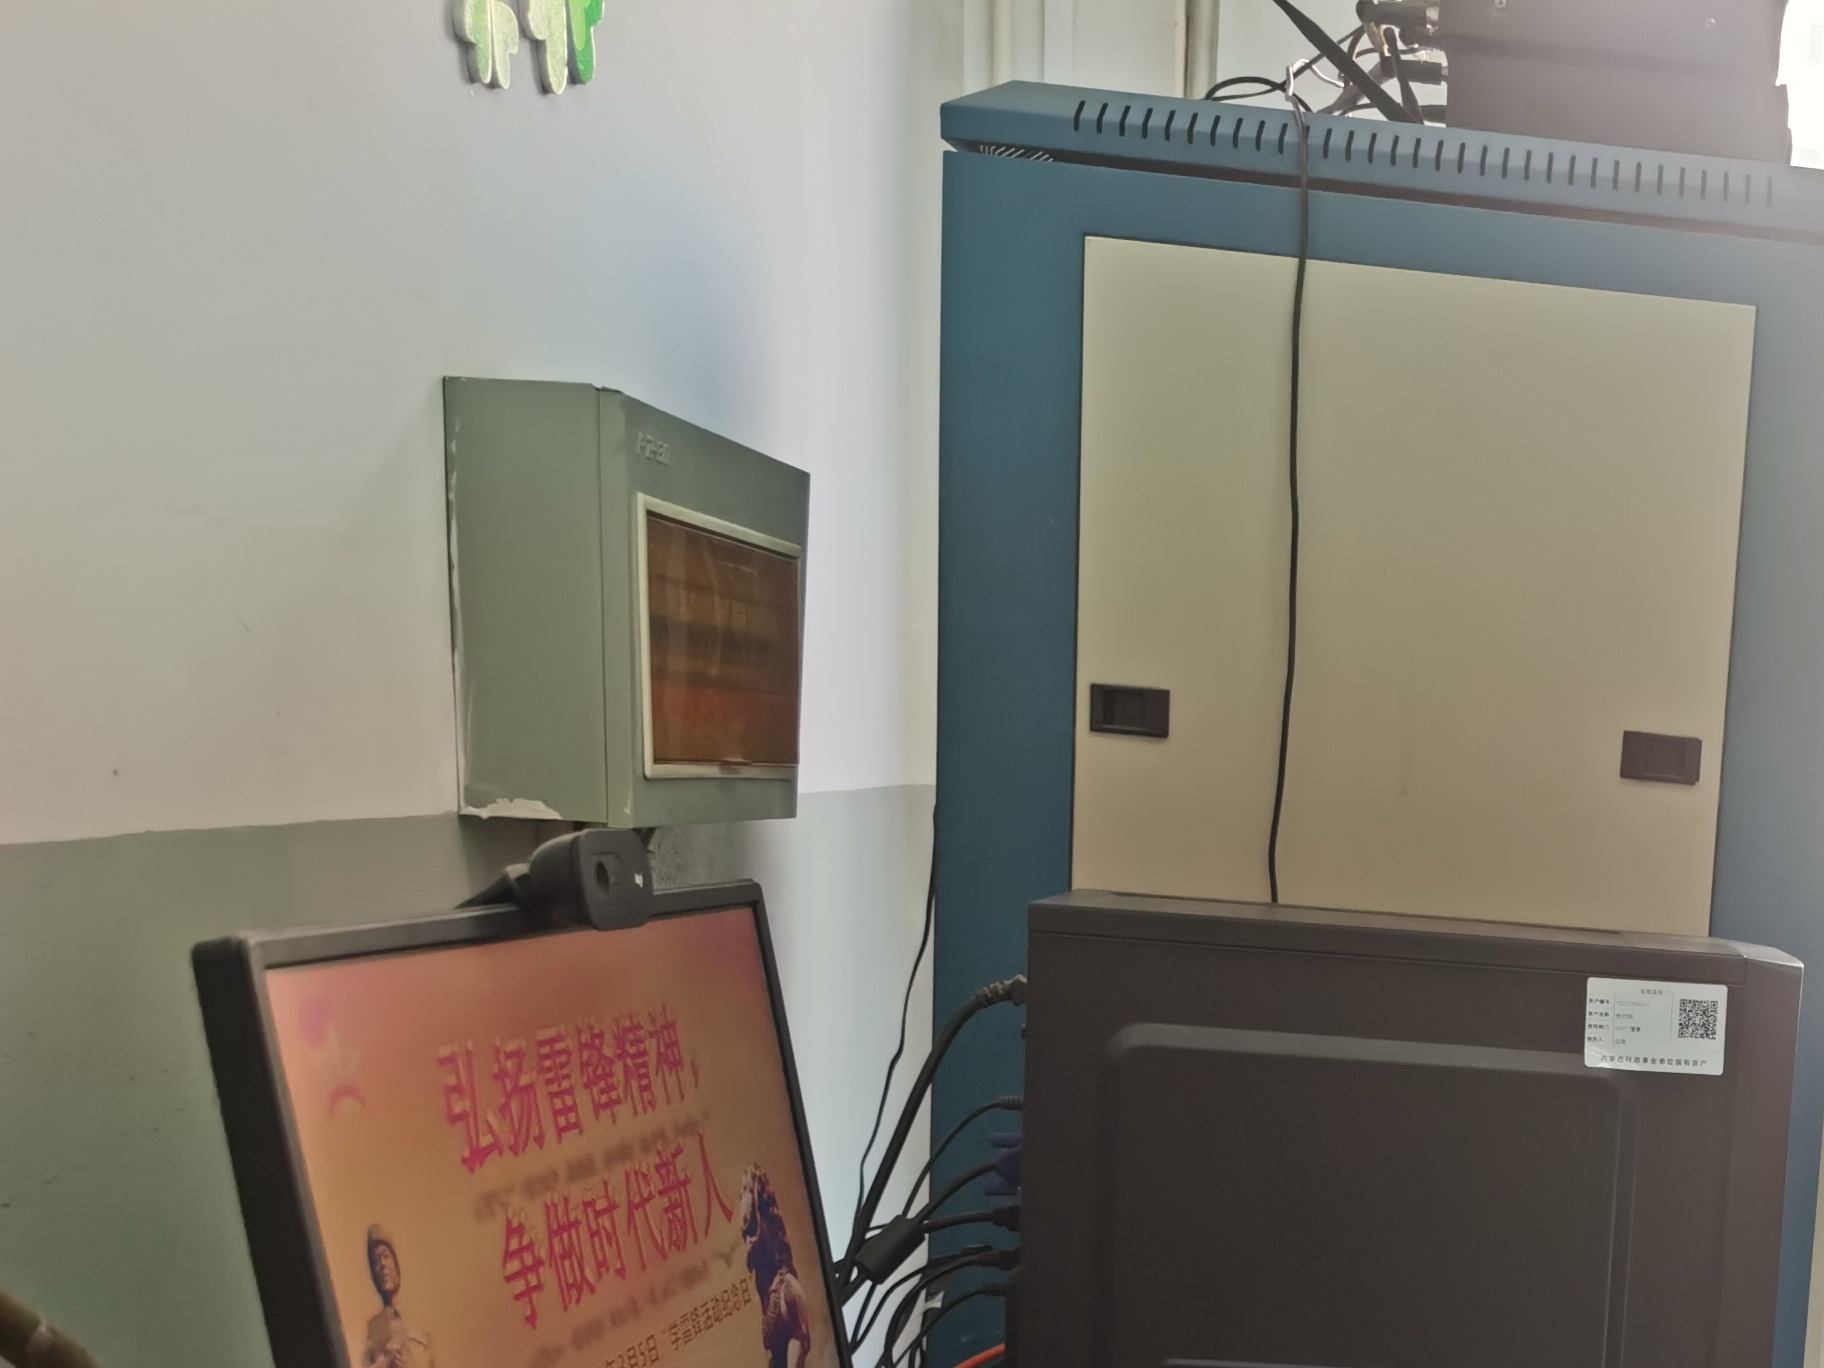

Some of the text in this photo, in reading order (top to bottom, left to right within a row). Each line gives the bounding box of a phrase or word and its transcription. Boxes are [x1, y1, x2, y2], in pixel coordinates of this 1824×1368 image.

[502, 1130, 734, 1330] 争做时代新人
